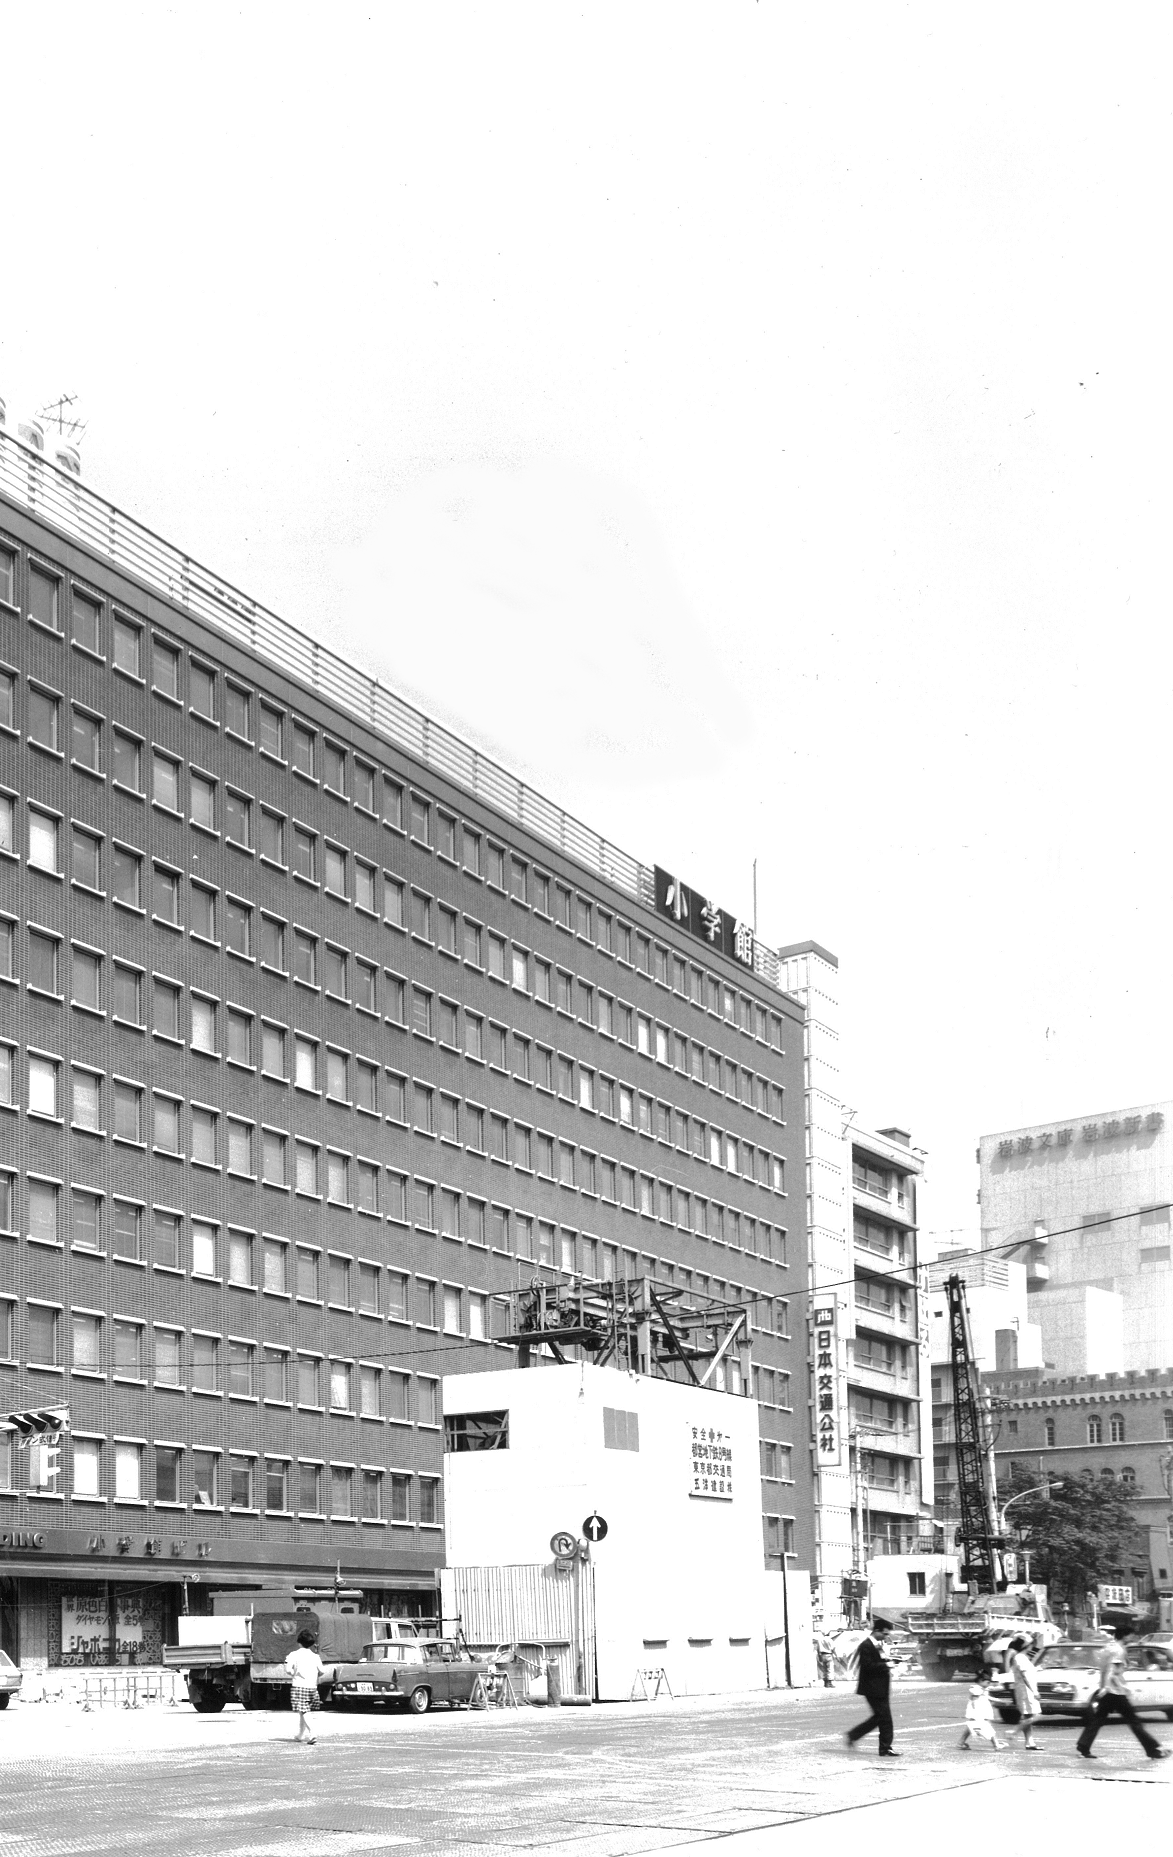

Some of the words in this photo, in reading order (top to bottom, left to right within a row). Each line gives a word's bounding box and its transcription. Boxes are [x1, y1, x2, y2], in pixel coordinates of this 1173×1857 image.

[665, 878, 754, 966] 小学館
[817, 1331, 835, 1452] 日本交通公社
